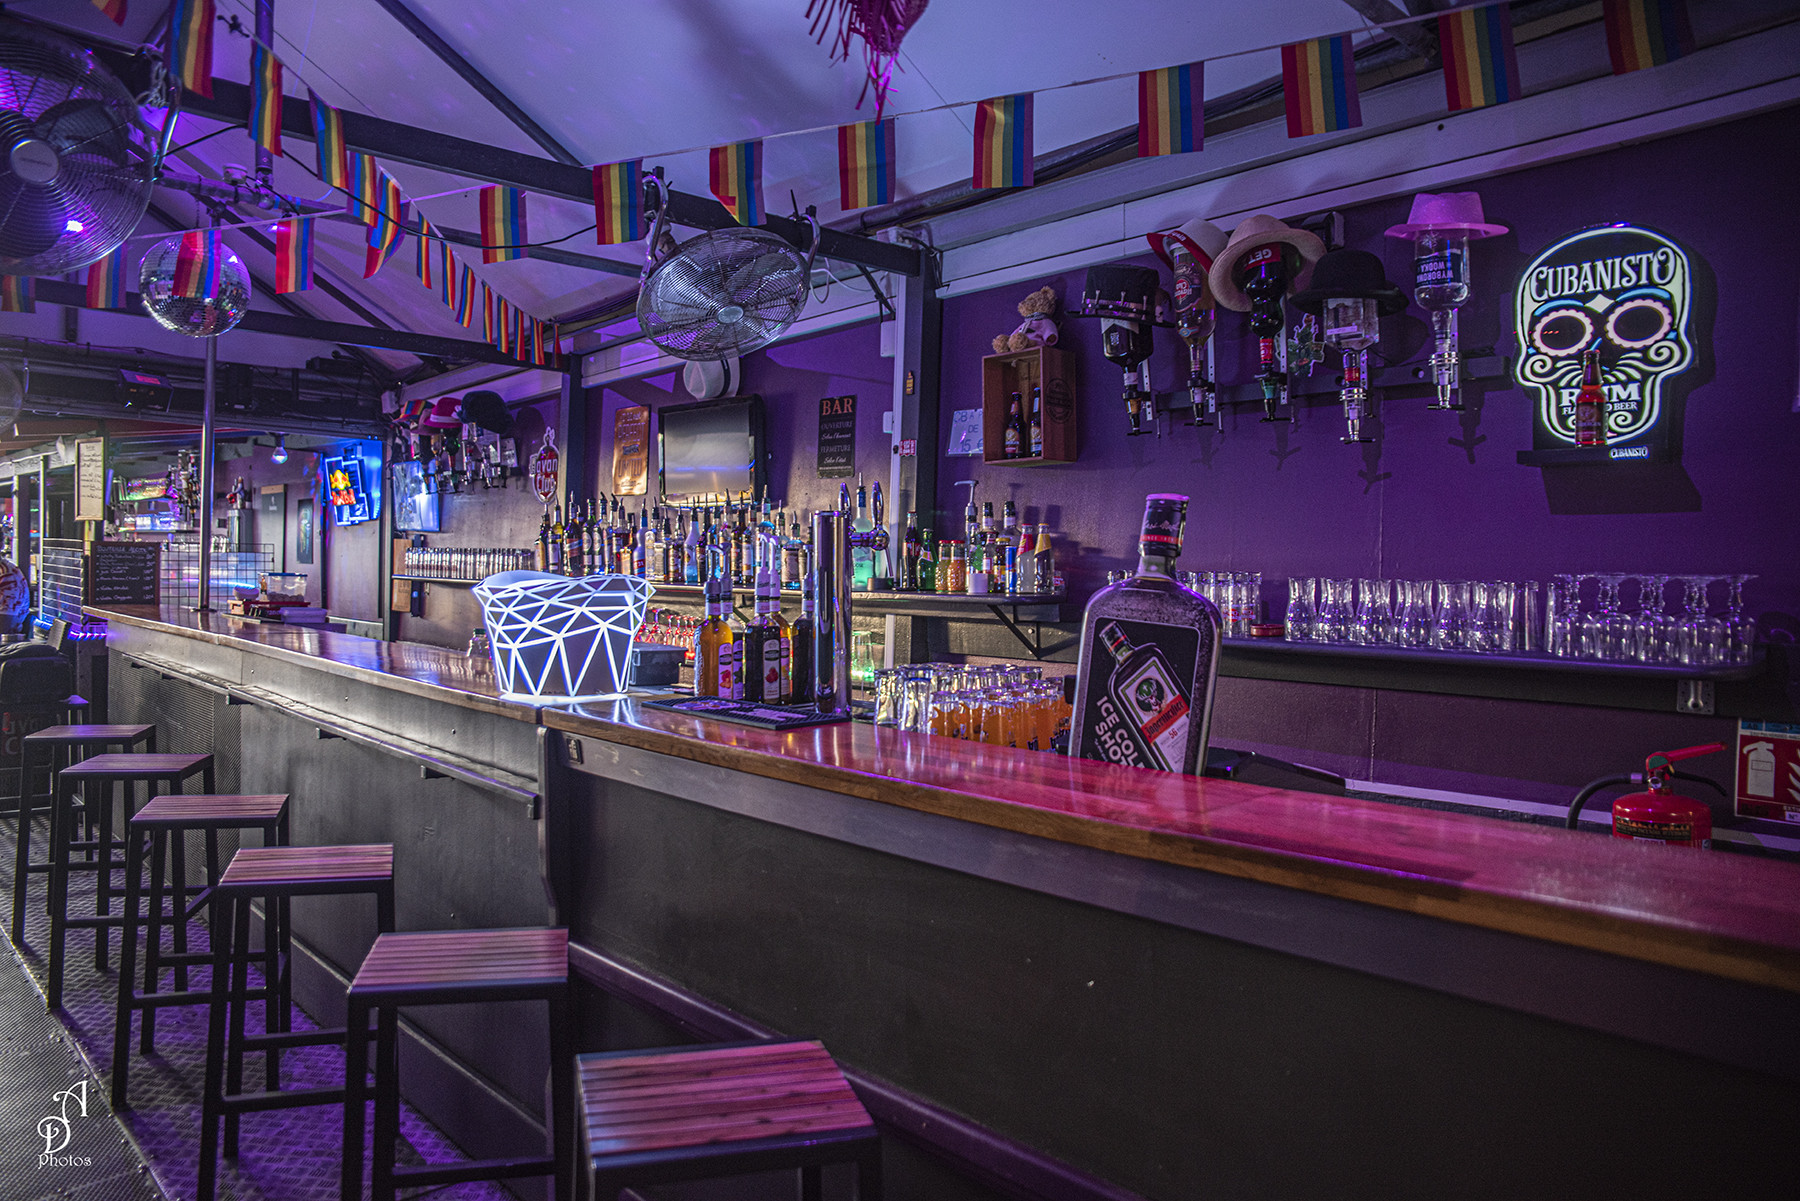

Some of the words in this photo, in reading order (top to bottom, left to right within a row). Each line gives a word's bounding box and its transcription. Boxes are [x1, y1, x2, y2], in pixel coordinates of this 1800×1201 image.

[1530, 247, 1676, 301] CUBANISTO
[822, 398, 853, 415] BAR
[1613, 401, 1638, 411] BEER
[954, 411, 968, 423] CB
[968, 424, 979, 434] DE
[960, 439, 971, 452] 15
[1610, 446, 1649, 459] CUBANISTO
[1096, 696, 1120, 728] ICE
[1168, 728, 1179, 739] 56
[1115, 728, 1146, 768] COL
